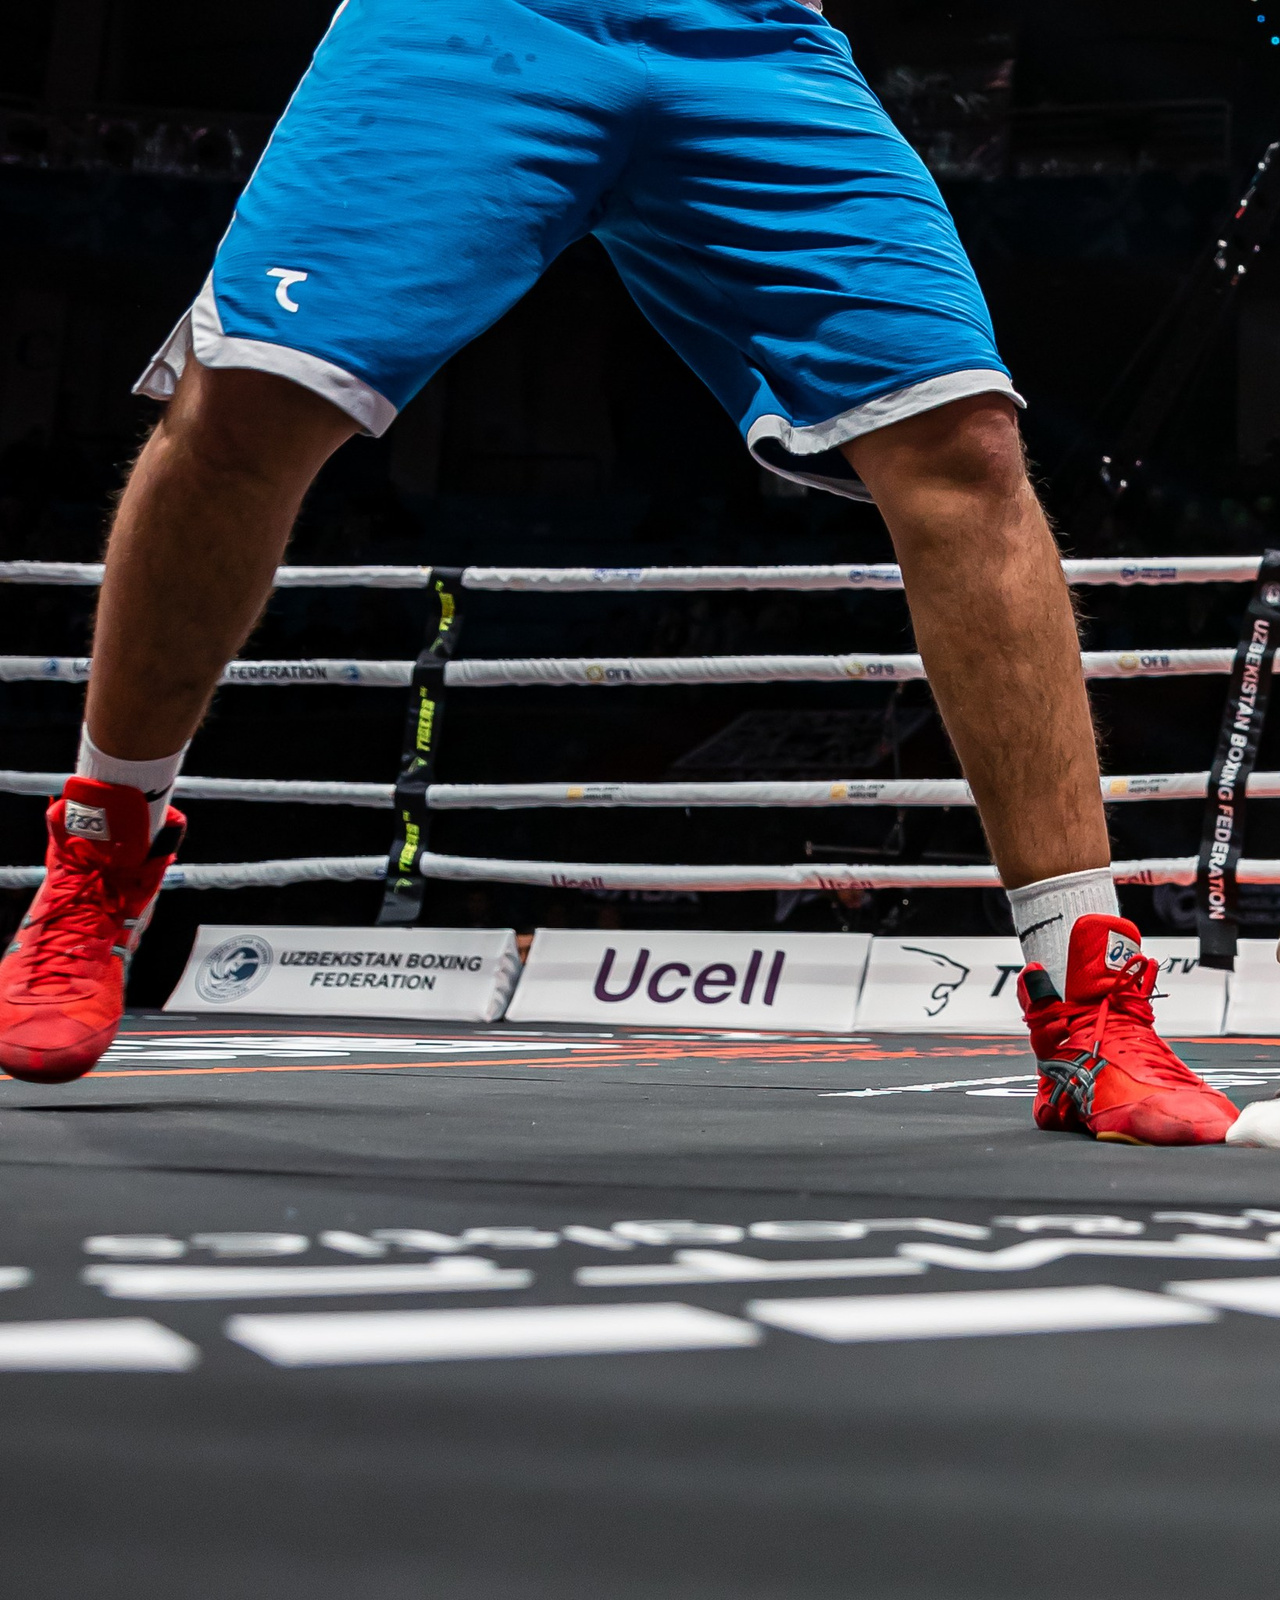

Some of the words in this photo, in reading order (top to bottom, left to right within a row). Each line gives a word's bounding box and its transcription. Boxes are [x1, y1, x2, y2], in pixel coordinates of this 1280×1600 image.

[230, 665, 328, 680] FEDERATION
[1233, 619, 1270, 732] UZBEKISTAN
[1217, 733, 1248, 801] BOXING
[1208, 804, 1235, 920] FEDERATION
[279, 951, 401, 970] UZBEKISTAN
[406, 952, 482, 972] BOXING
[310, 972, 437, 990] FEDERATION
[592, 947, 784, 1006] Ucell
